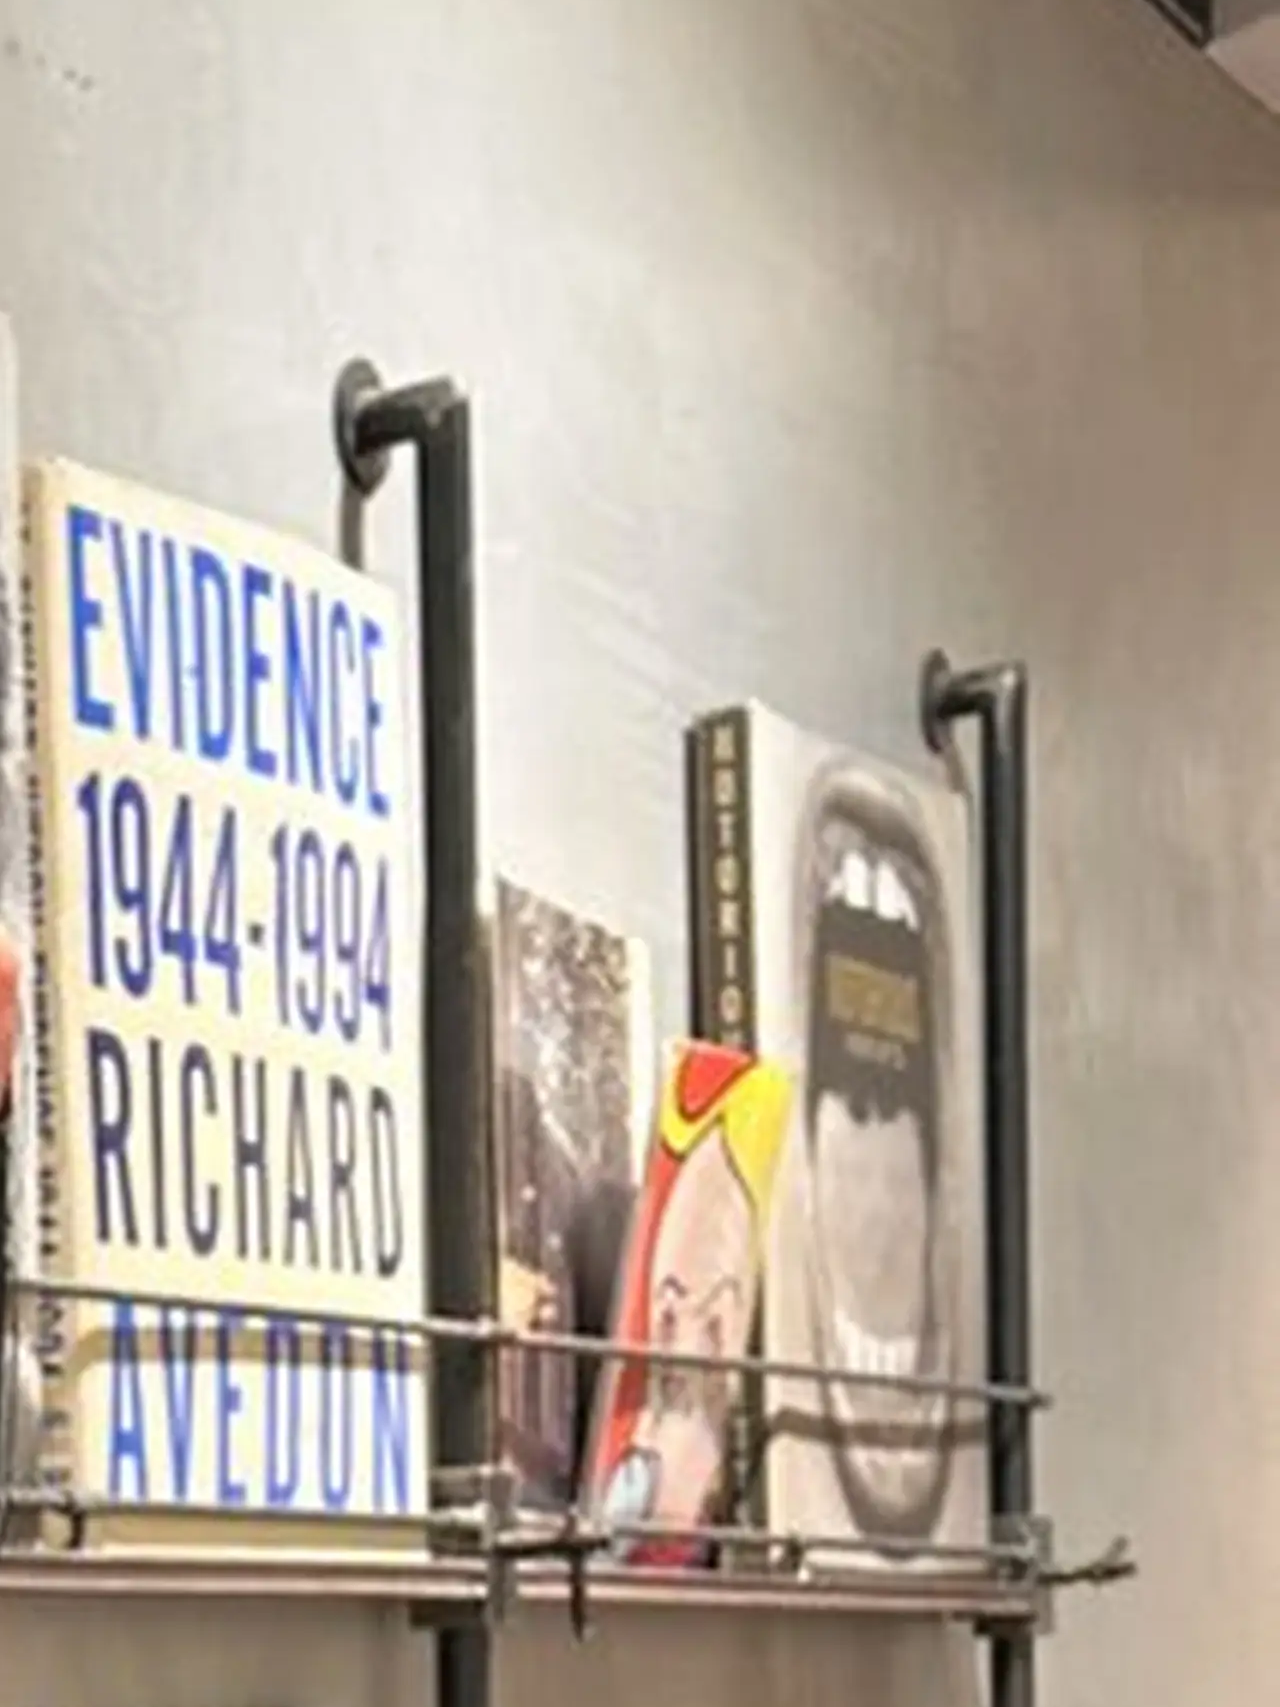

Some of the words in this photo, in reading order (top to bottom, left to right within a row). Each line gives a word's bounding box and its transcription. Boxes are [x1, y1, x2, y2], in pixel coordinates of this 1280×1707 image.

[68, 505, 390, 814] EVIDENCE
[78, 773, 394, 1051] 1944-1994
[87, 1028, 404, 1278] RICHARD
[108, 1297, 409, 1513] AVEDON
